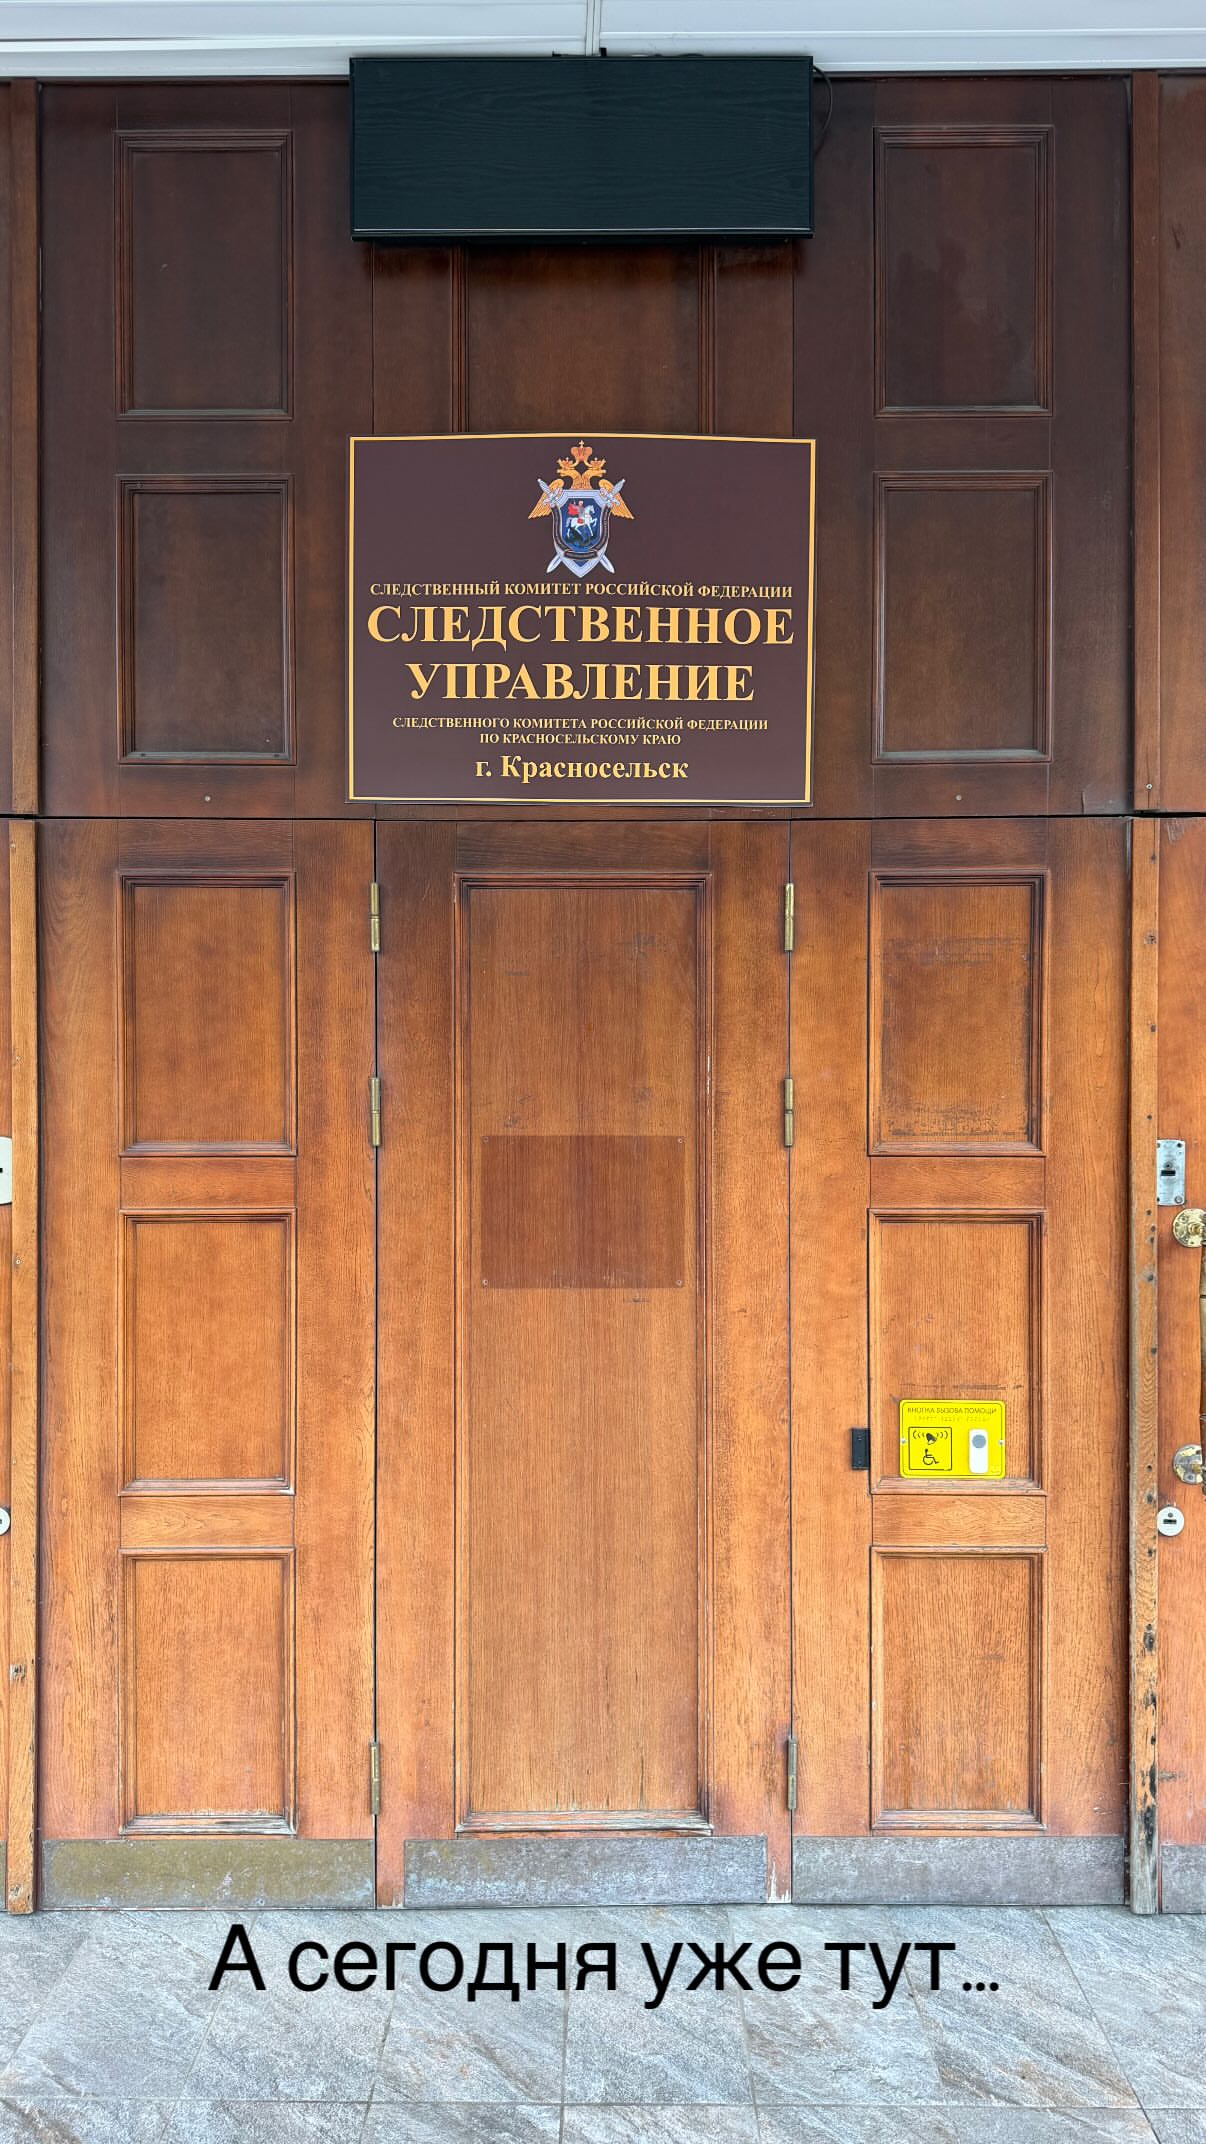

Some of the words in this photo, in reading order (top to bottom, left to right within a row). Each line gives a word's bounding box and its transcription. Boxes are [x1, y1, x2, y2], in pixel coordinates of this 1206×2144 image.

[370, 581, 500, 597] СЛЕДСТВЕННЫЙ
[504, 583, 582, 595] КОМИТЕТ
[585, 581, 694, 597] РОССИЙСКОЙ
[698, 585, 793, 599] ФЕДЕРАЦИИ
[367, 605, 794, 652] СЛЕДСТВЕННОЕ
[405, 663, 755, 701] УПРАВЛЕНИЕ
[392, 717, 510, 729] СЛЕДСТВЕННОГО
[513, 718, 588, 729] КОМИТЕТА
[591, 717, 684, 730] РОССИЙСКОЙ
[687, 719, 768, 731] ФЕДЕРАЦИИ
[479, 733, 500, 744] ПО
[503, 733, 639, 745] КРАСНОСЕЛЬСКОМУ
[642, 734, 682, 745] КРАЮ
[475, 761, 492, 777] г.
[500, 755, 689, 784] Красносельск
[964, 1407, 997, 1415] ПОМОЩИ
